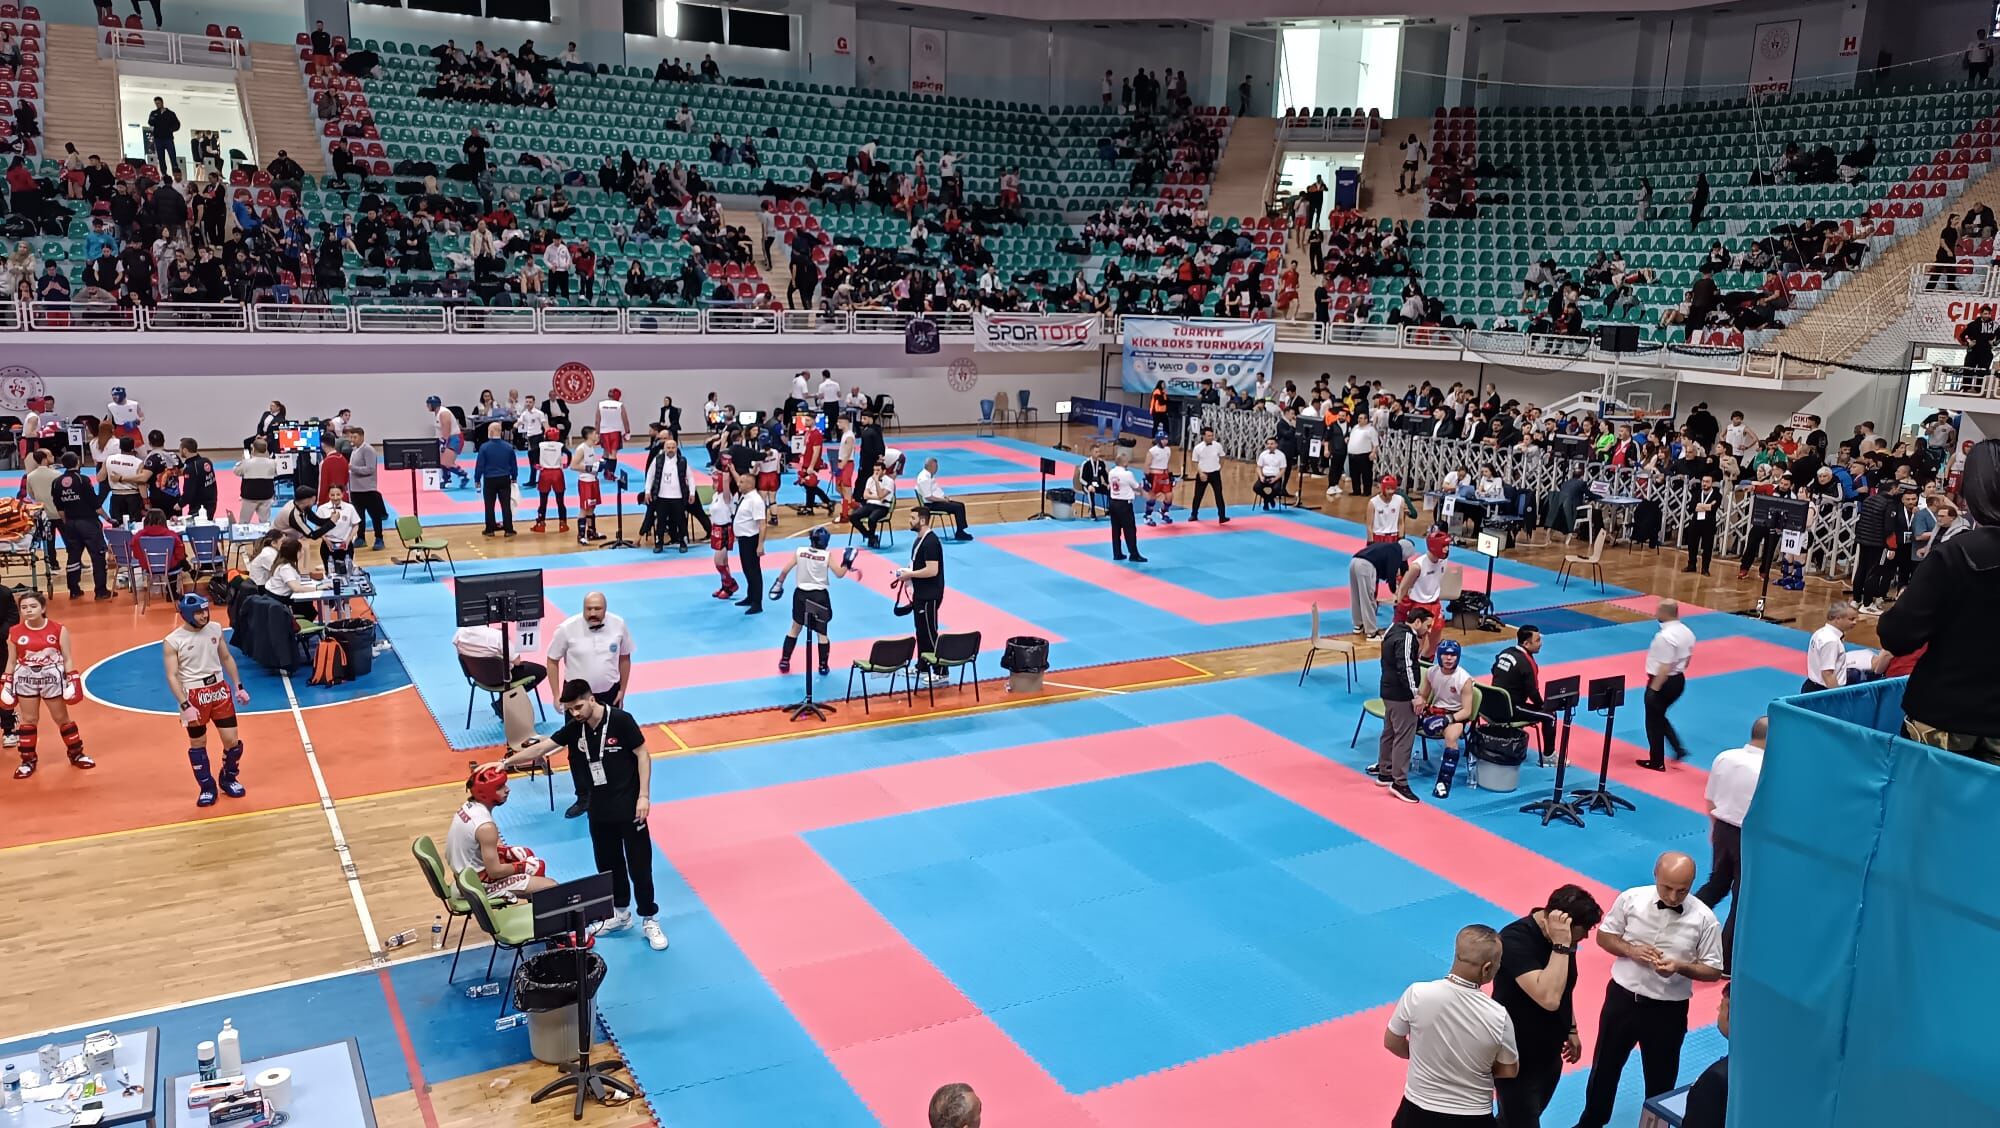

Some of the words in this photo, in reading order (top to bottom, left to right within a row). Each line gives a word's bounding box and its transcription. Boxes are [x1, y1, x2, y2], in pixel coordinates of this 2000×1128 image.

[837, 36, 848, 50] G
[1844, 36, 1856, 51] H
[912, 81, 943, 91] SPOR
[1172, 327, 1225, 338] TÜRKİYE
[1161, 338, 1193, 349] BOKS
[1195, 340, 1264, 351] TURNUVASI
[281, 461, 288, 470] 3
[429, 476, 434, 485] 7
[1785, 538, 1795, 549] 10
[521, 632, 533, 646] 11
